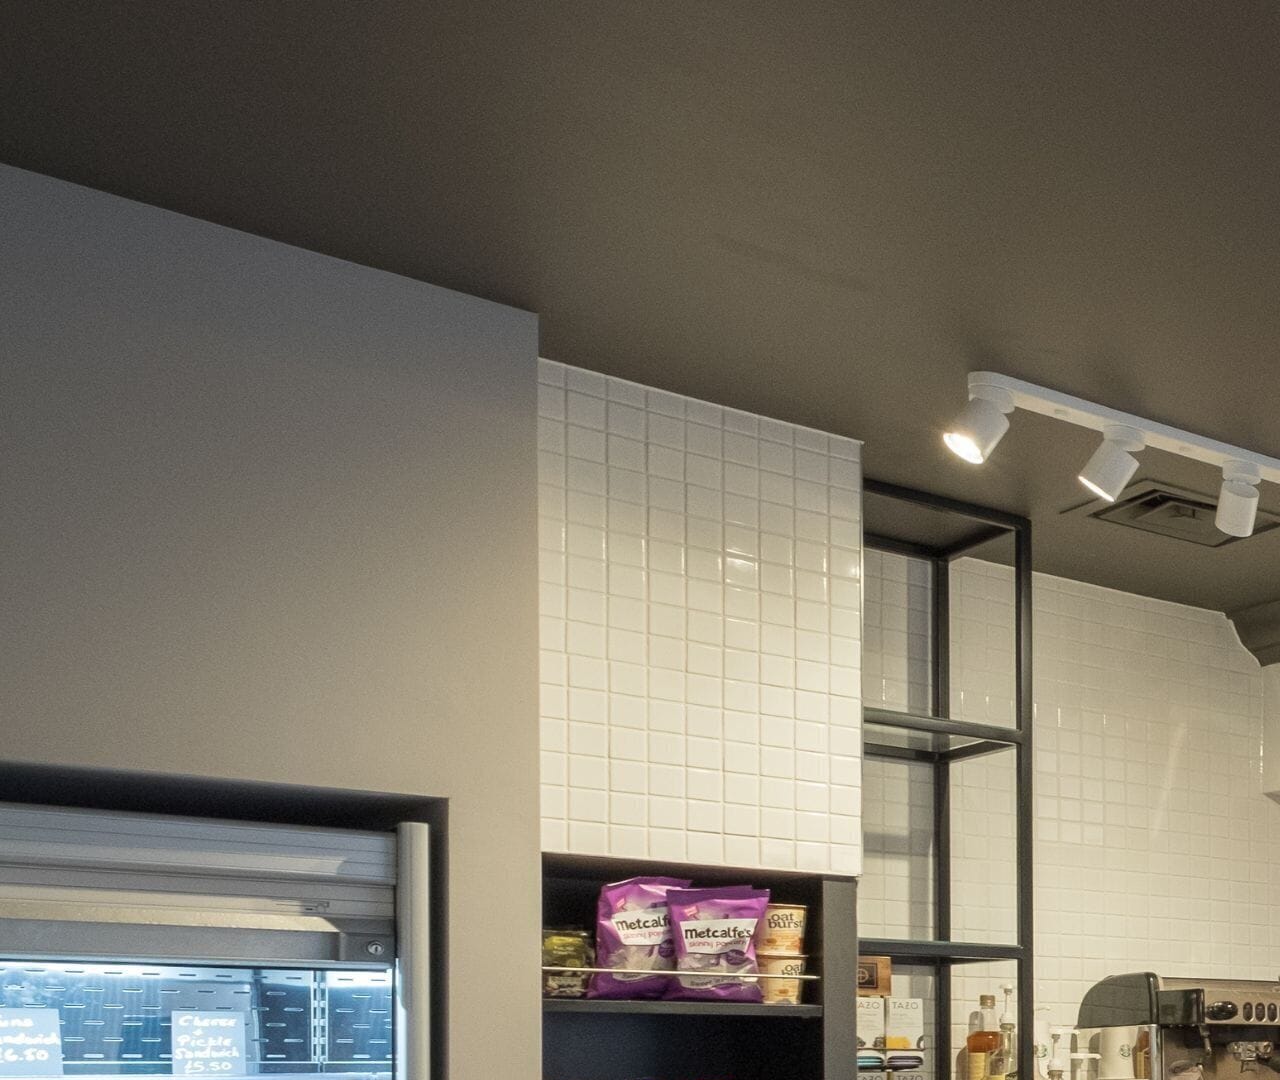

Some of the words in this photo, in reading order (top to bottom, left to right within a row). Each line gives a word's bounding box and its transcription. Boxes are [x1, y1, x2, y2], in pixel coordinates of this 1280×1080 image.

[857, 1001, 880, 1009] AZO
[892, 1002, 919, 1010] TAZO
[0, 1014, 34, 1028] una
[177, 1035, 233, 1047] Pickle
[174, 1047, 240, 1059] Sandwich
